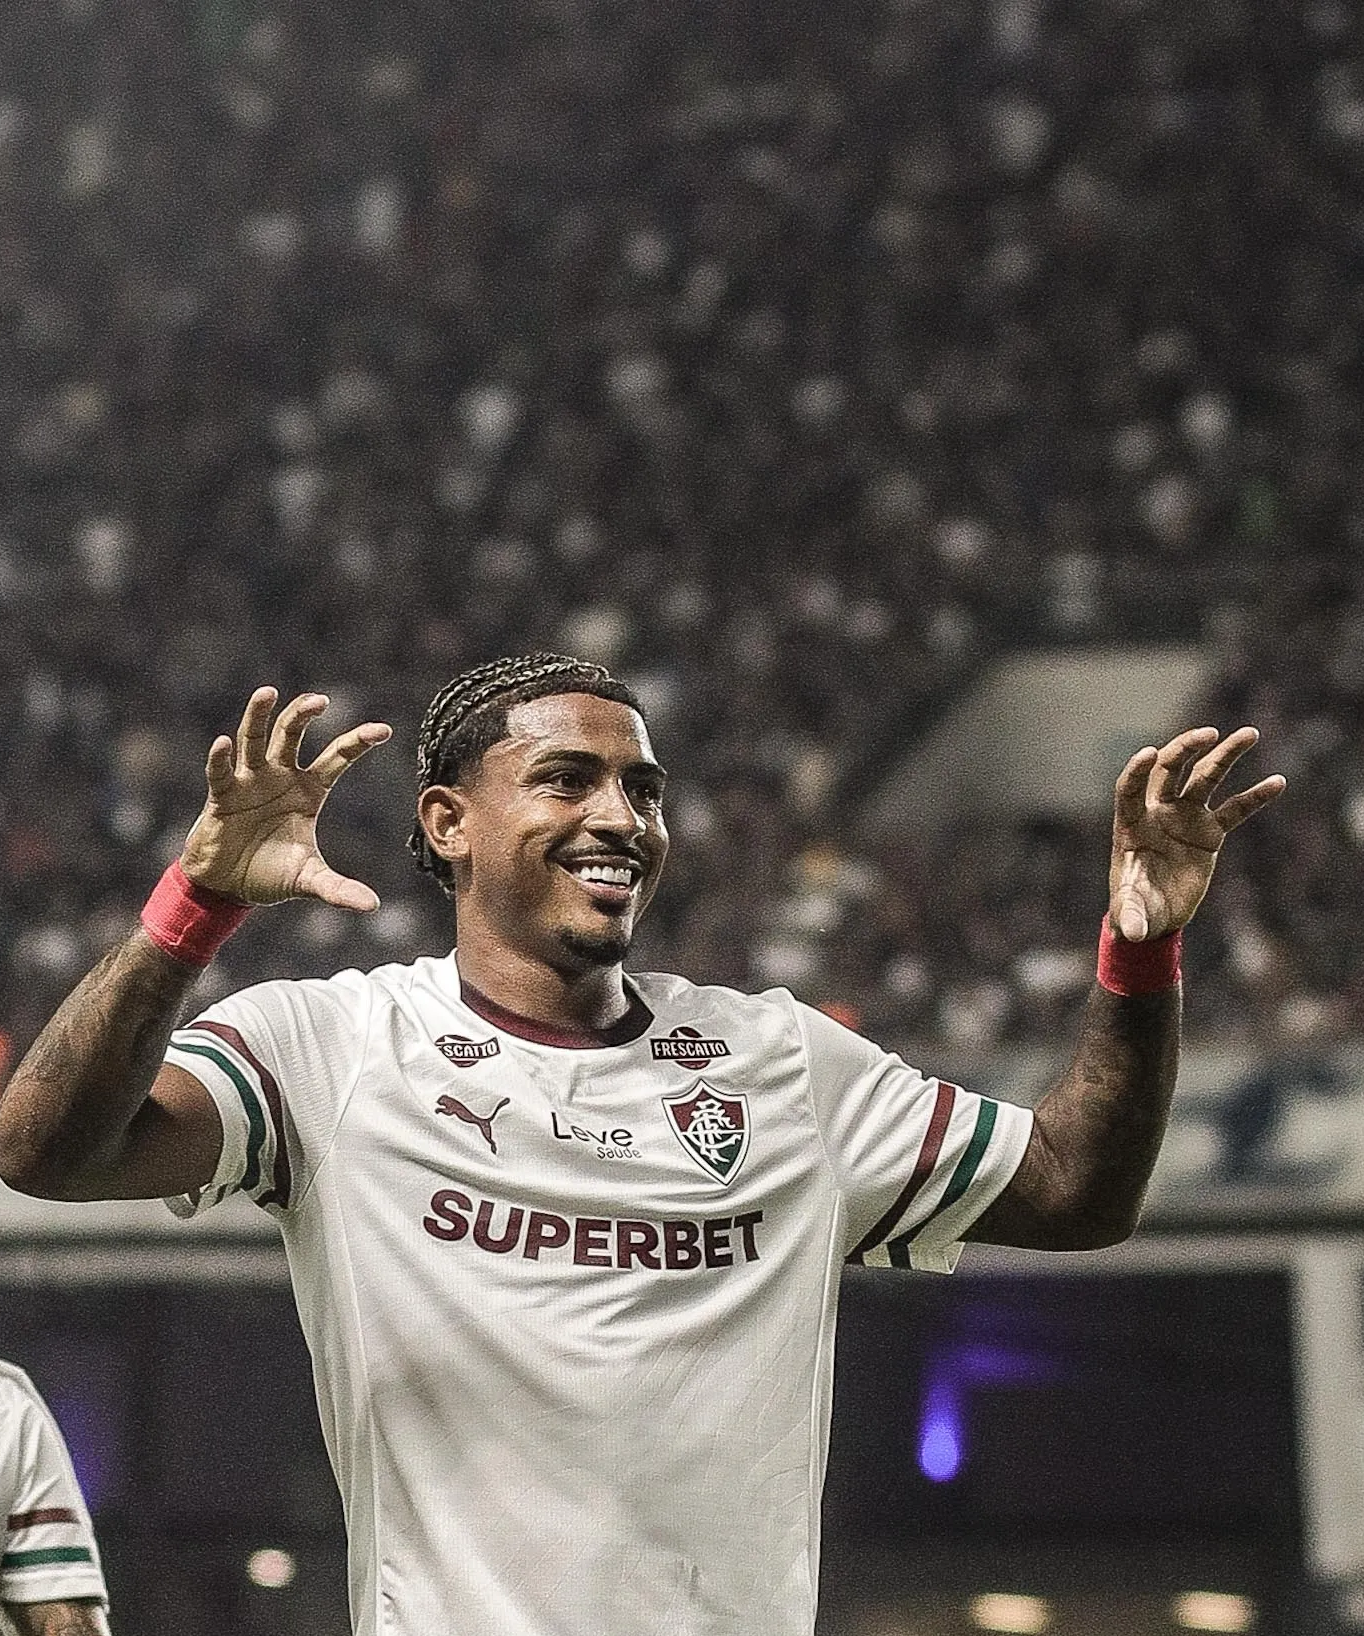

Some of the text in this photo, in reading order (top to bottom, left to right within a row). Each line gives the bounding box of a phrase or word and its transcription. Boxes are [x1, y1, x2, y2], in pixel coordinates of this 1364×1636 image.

[653, 1040, 727, 1057] FRESCATTO
[551, 1112, 634, 1148] Leve
[423, 1188, 763, 1271] SUPERBET
